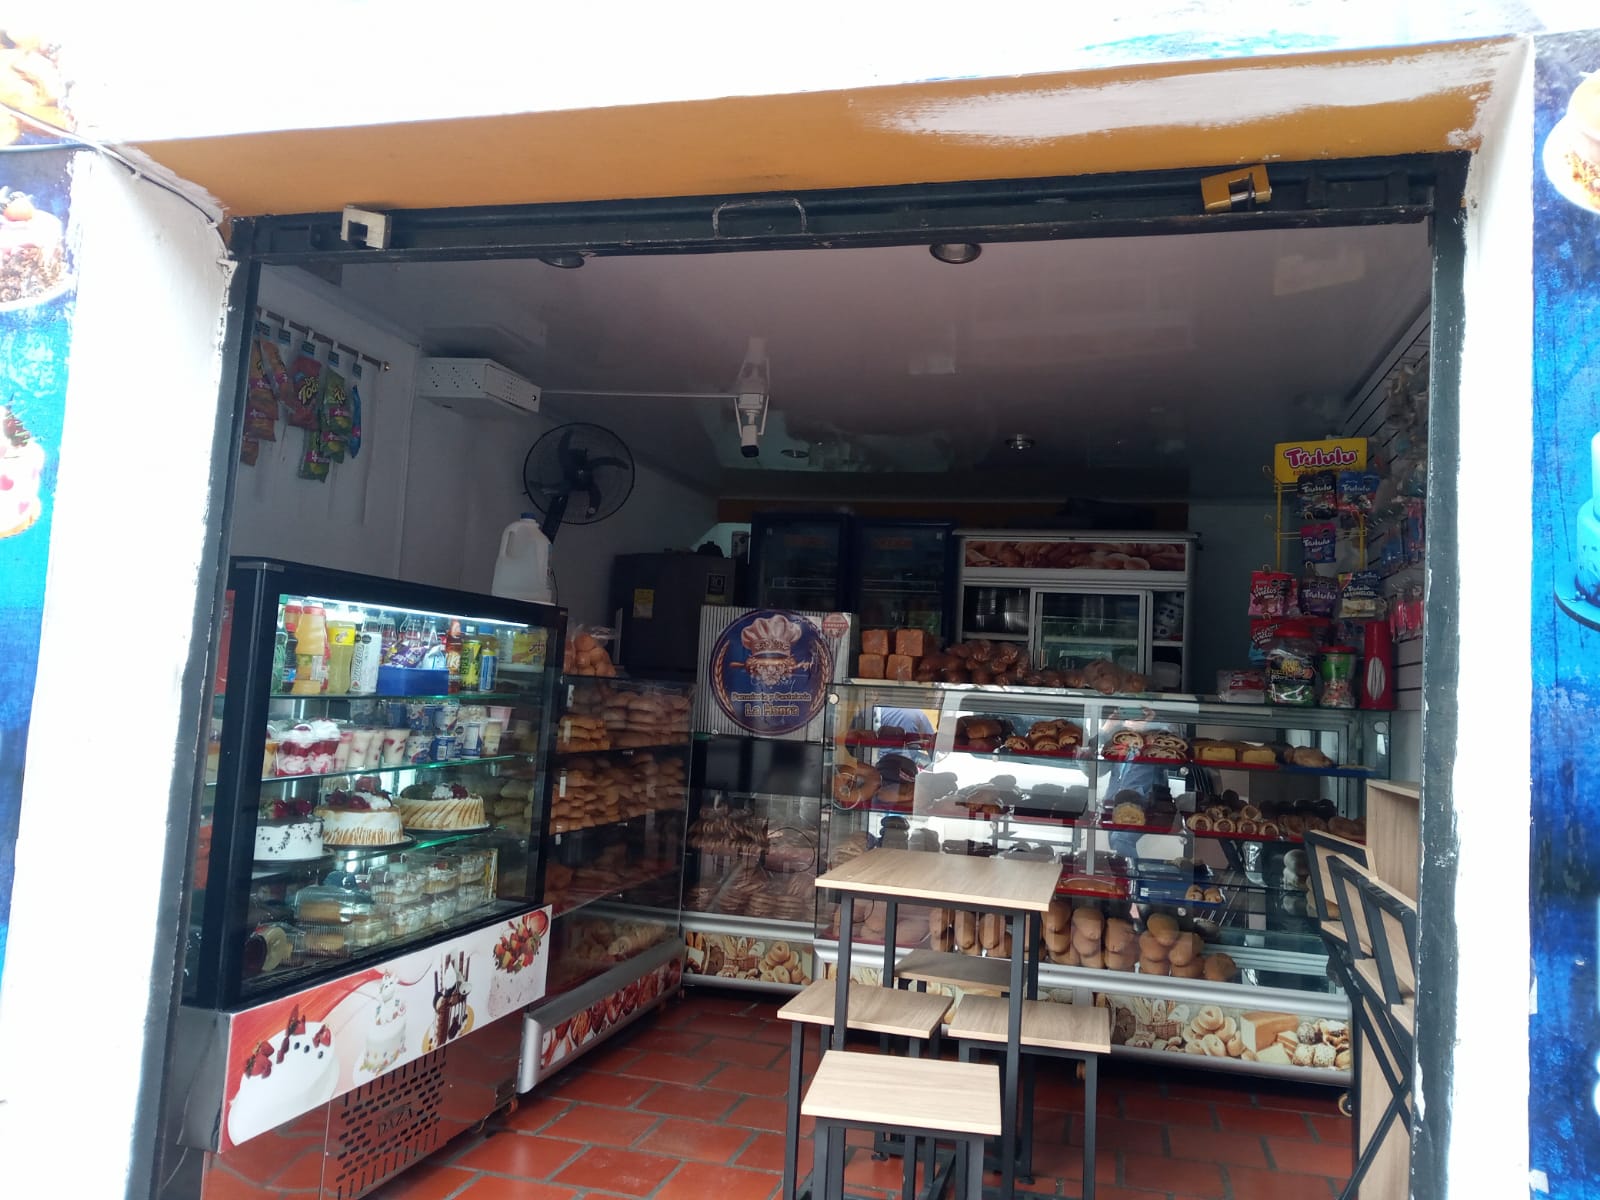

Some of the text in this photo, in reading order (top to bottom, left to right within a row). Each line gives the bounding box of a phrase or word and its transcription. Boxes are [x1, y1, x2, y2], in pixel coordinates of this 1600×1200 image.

[1284, 446, 1356, 468] Trululu
[1301, 483, 1332, 493] Trululu
[1302, 588, 1337, 600] Trululu
[745, 703, 761, 716] La
